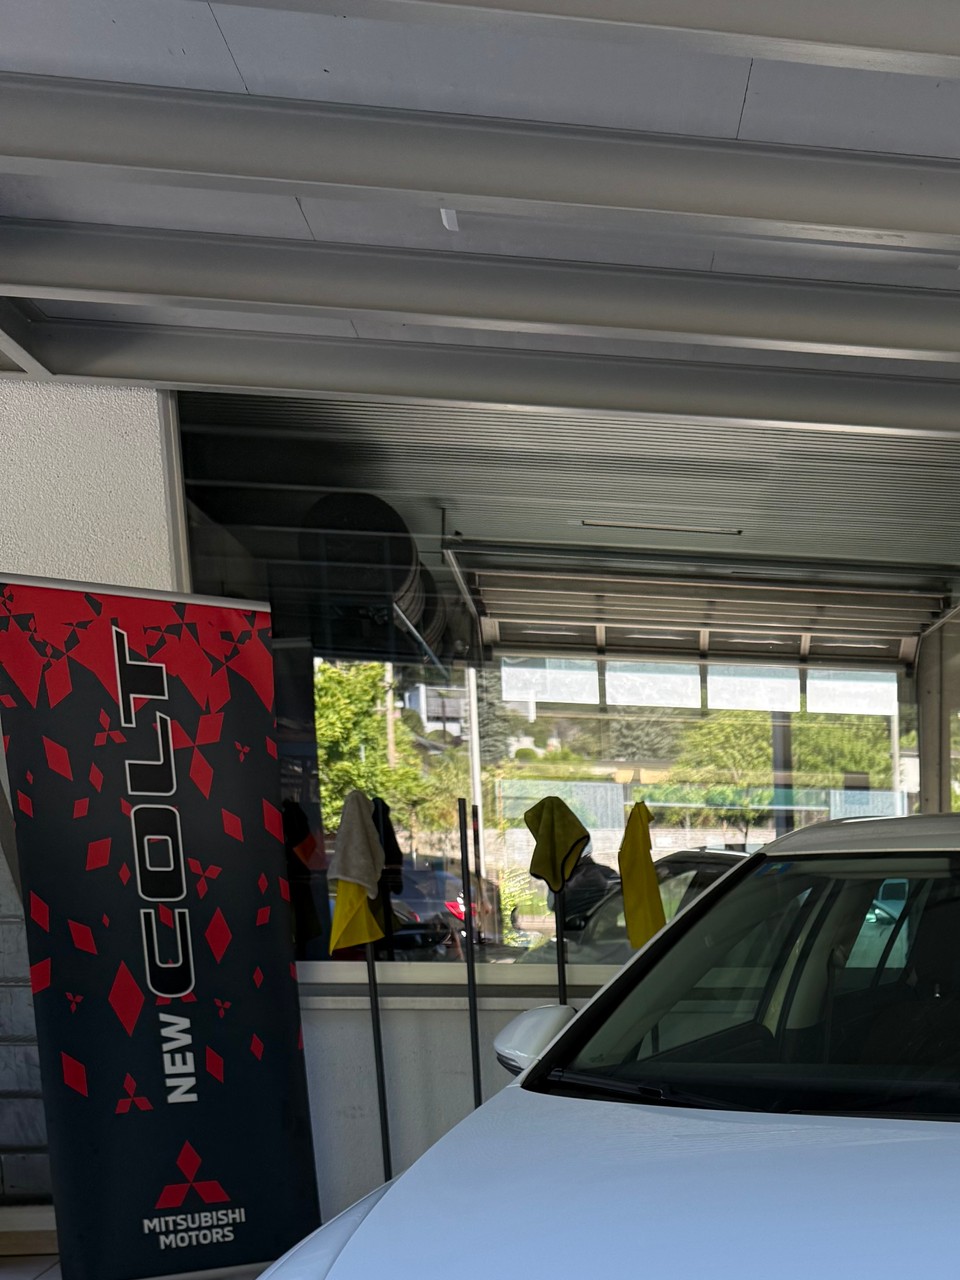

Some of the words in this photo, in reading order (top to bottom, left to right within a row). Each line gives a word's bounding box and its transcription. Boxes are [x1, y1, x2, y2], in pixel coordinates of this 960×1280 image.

[112, 625, 196, 998] COLT
[158, 1012, 199, 1104] NEW
[143, 1208, 246, 1234] MITSUBISHI
[159, 1226, 235, 1250] MOTORS
